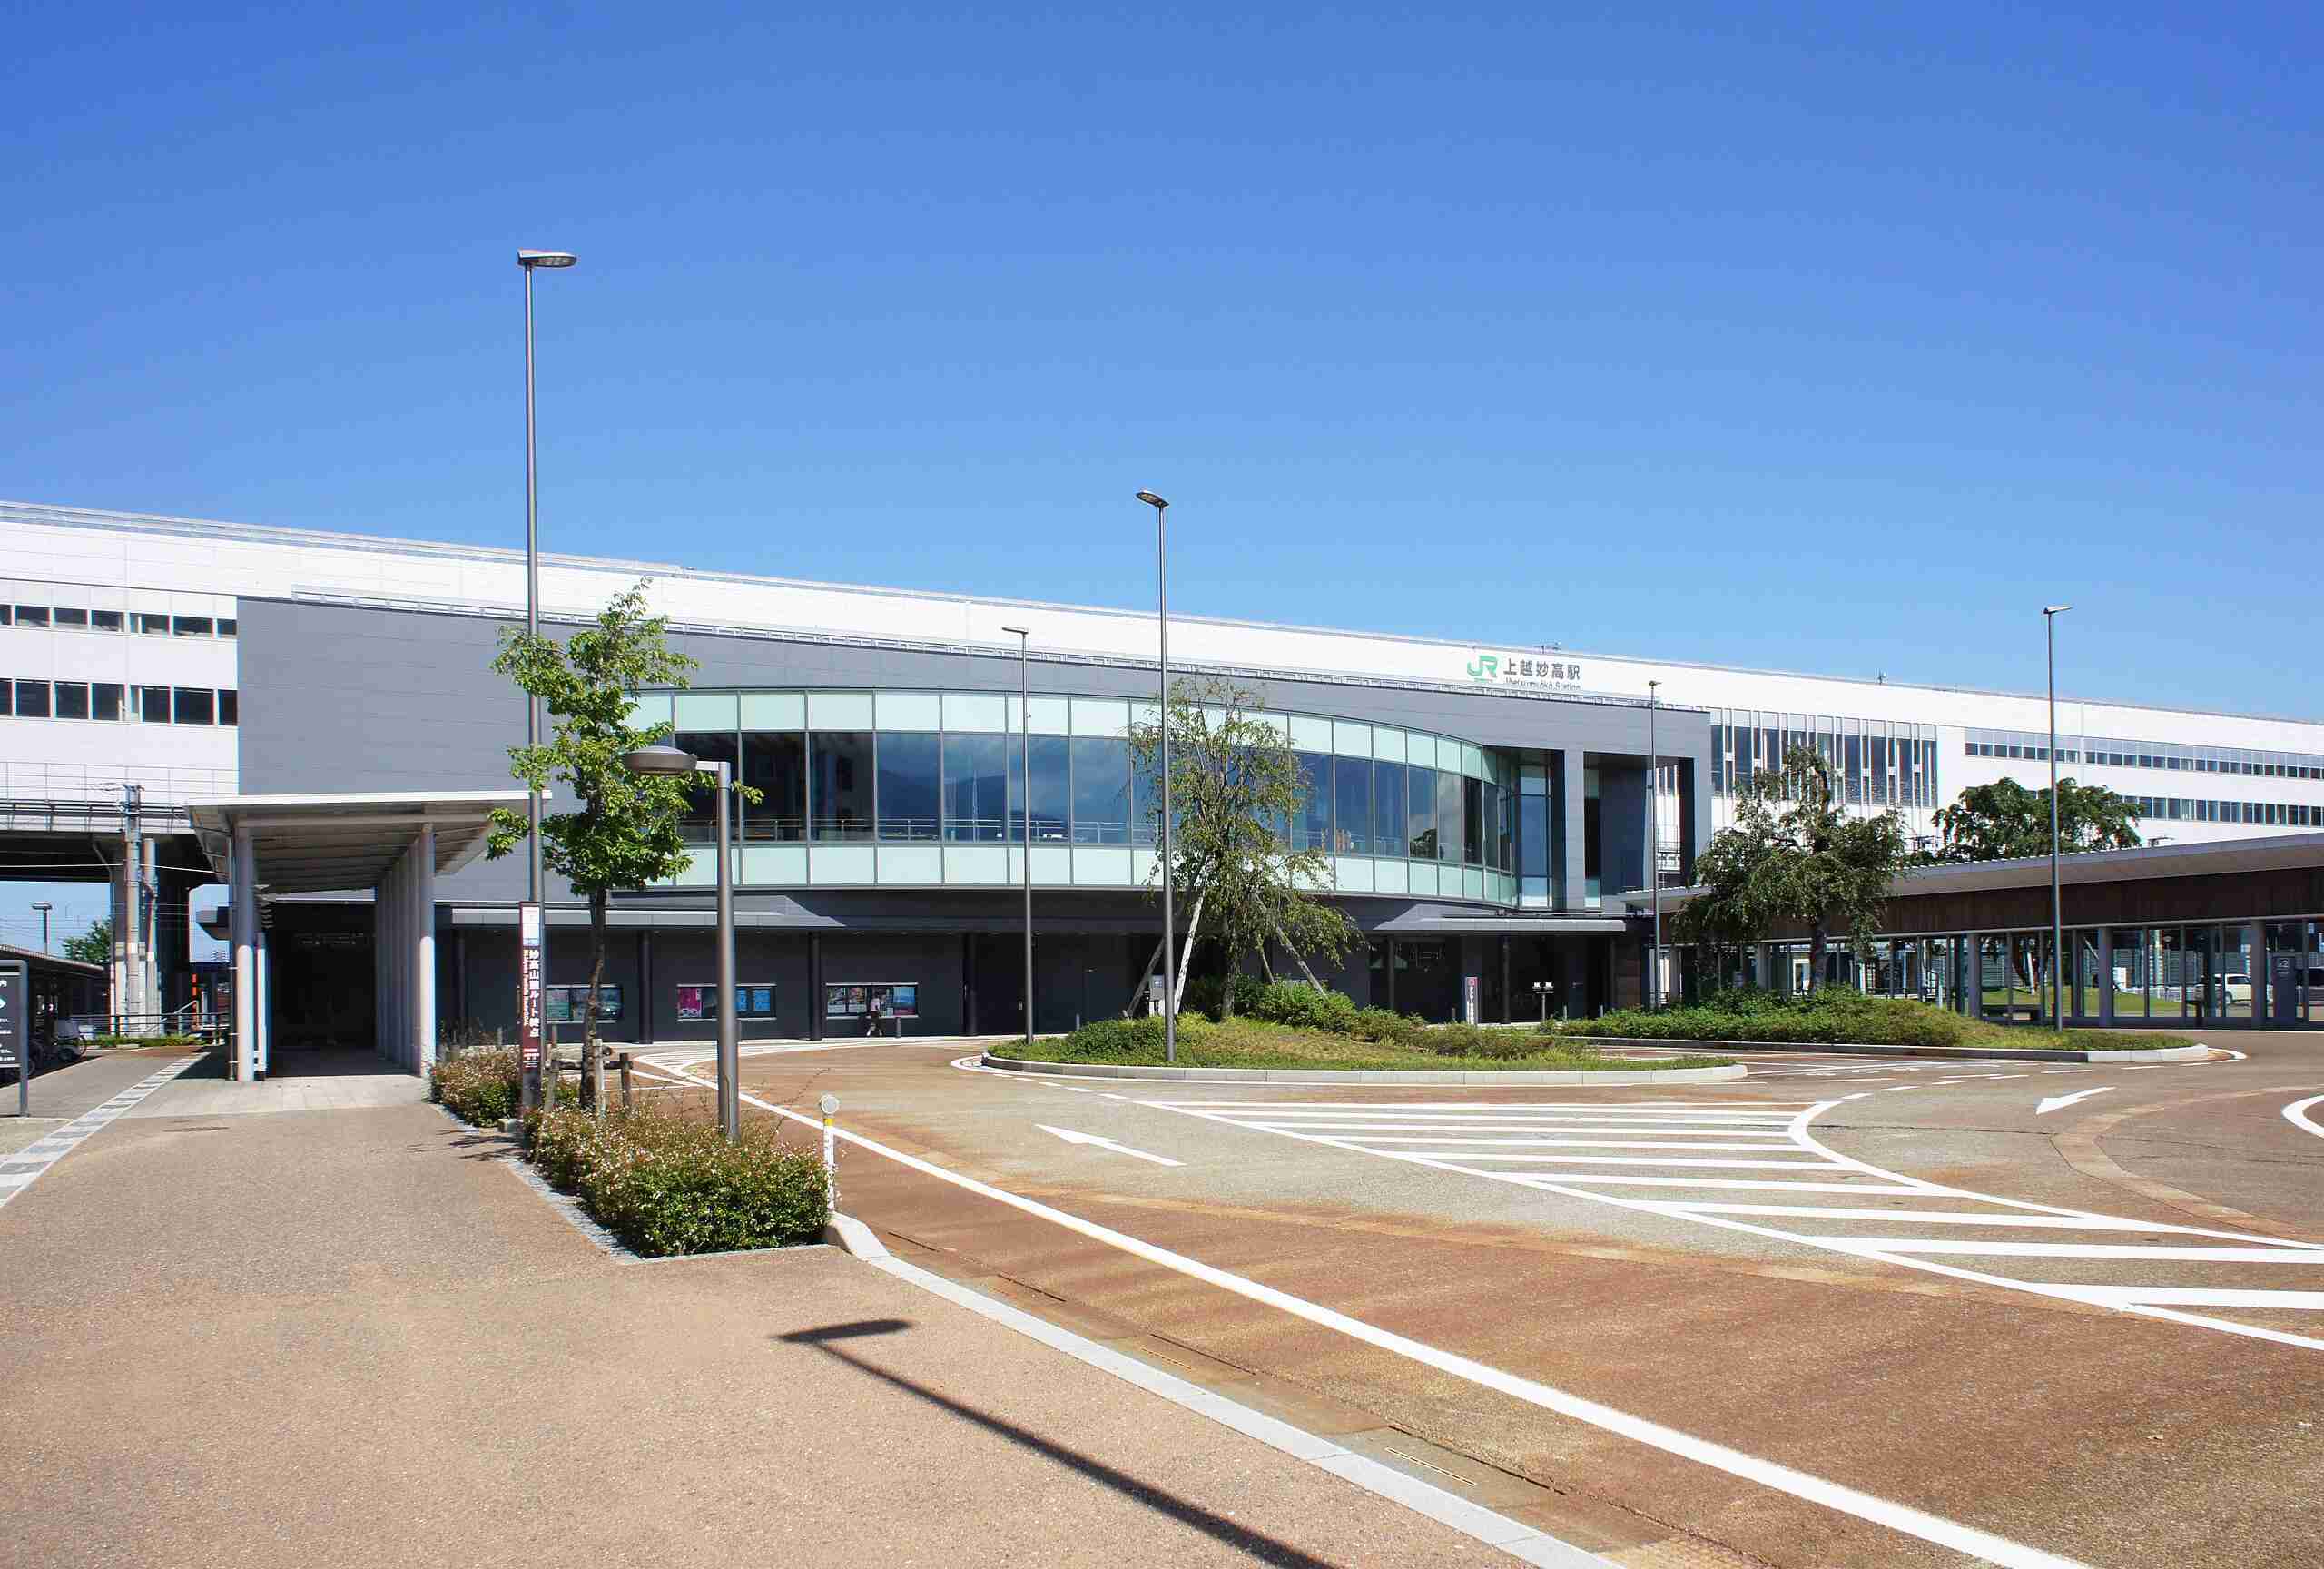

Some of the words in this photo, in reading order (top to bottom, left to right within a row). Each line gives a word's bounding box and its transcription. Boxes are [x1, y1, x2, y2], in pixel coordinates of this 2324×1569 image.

[1467, 656, 1498, 677] JR
[1503, 658, 1581, 680] 上越妙高駅
[529, 949, 540, 1037] 妙高山ルート終点
